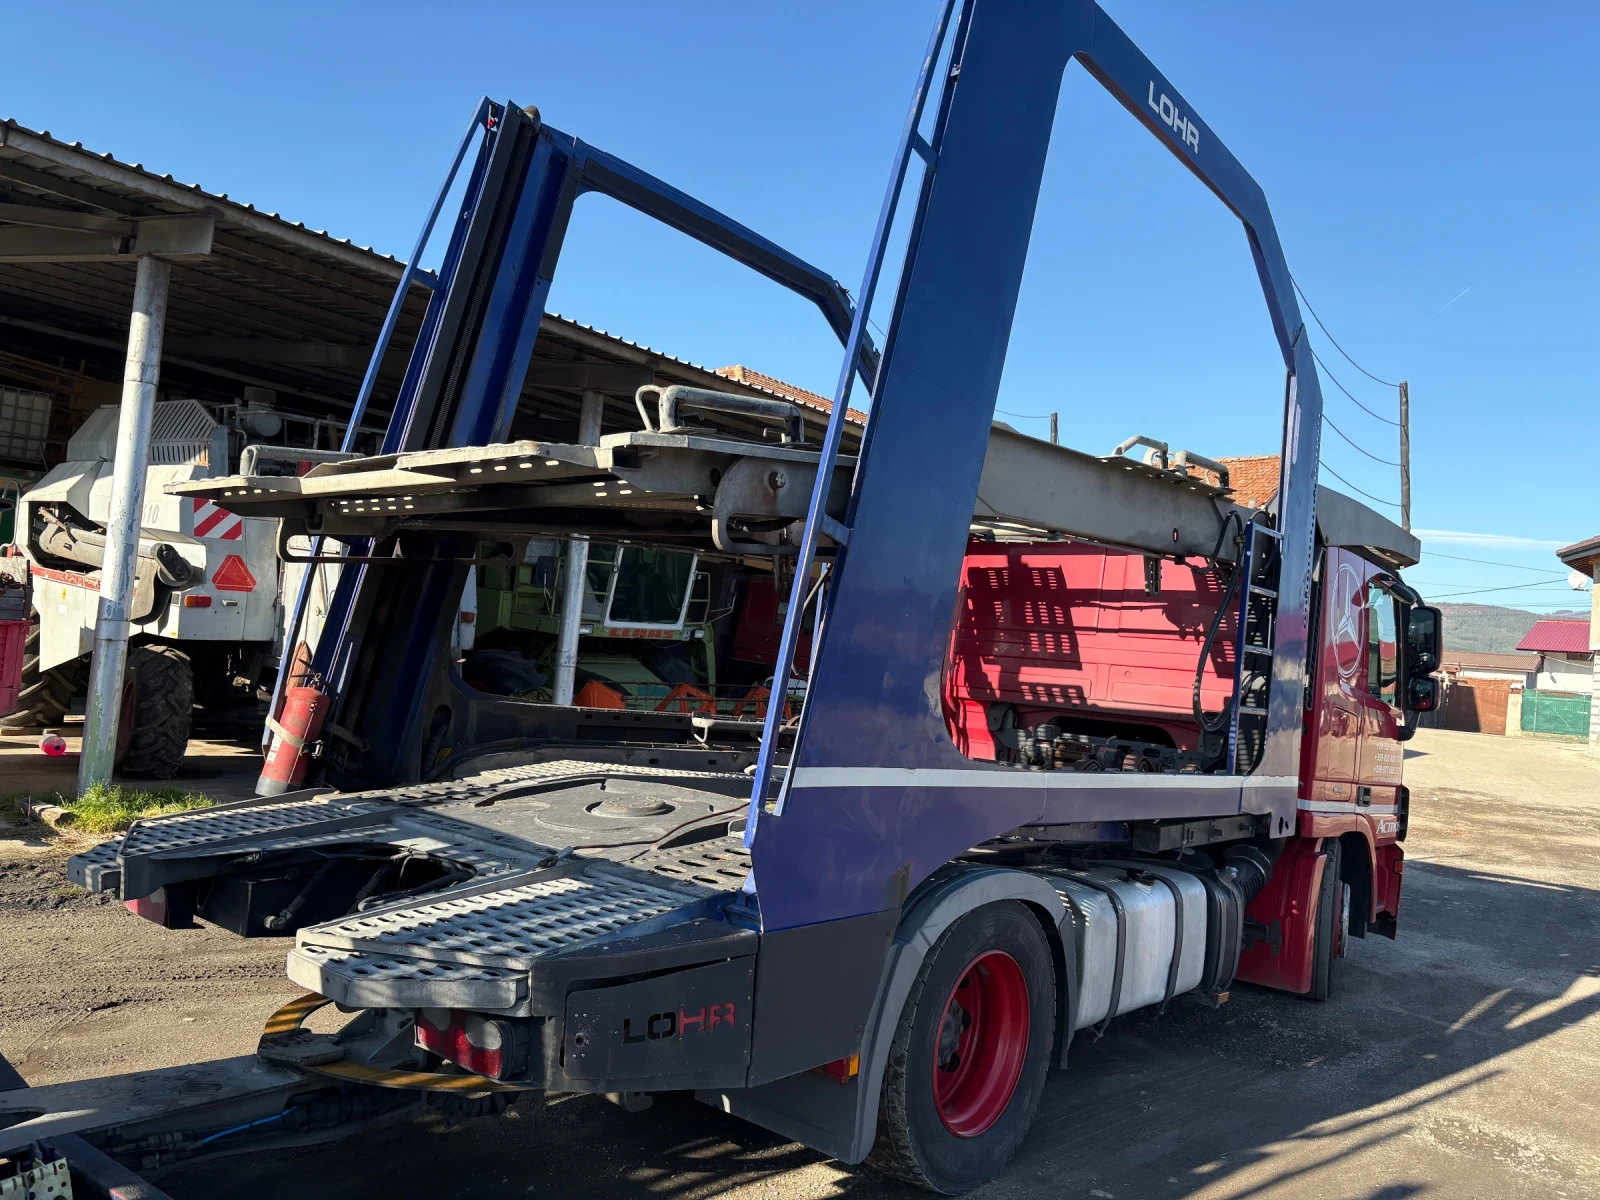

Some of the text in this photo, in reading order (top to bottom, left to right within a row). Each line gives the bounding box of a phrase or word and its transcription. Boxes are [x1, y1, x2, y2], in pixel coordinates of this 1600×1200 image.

[1148, 80, 1200, 154] LOHR
[608, 627, 674, 639] CLAAS
[622, 1002, 737, 1045] LOHR
